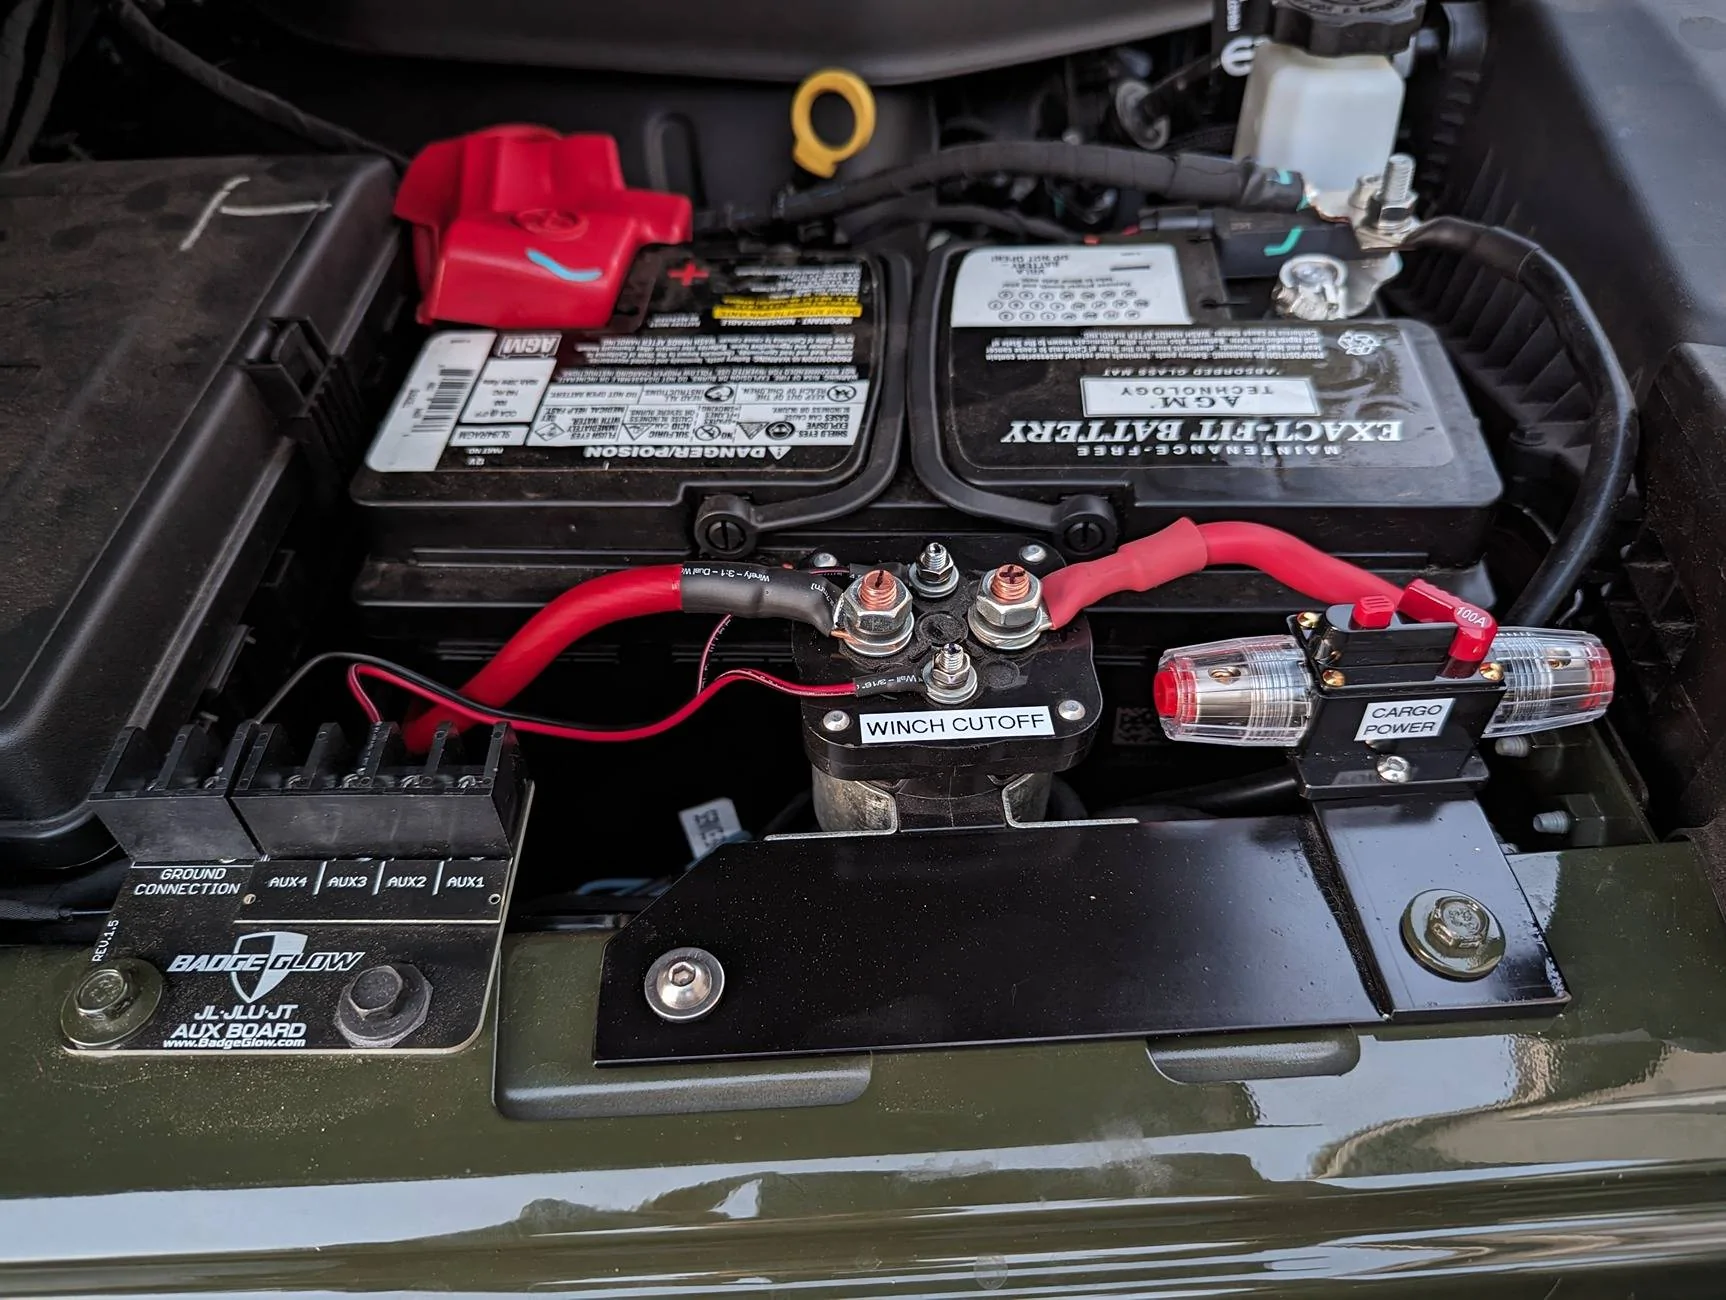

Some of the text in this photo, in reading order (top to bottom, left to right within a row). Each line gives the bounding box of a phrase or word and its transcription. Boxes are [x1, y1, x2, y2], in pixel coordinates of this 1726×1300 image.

[506, 338, 557, 354] AGM
[1102, 368, 1134, 376] MAT
[1138, 368, 1186, 376] GLASS
[1120, 386, 1272, 396] TECHNOLOGY
[1000, 420, 1402, 442] EXACT-FIT BATTERY
[584, 446, 766, 458] DANGER/POISON
[1076, 445, 1340, 456] MAINTENANCE-FREE
[721, 569, 734, 577] 3:1
[744, 572, 770, 582] Wirefy
[1456, 606, 1486, 628] 100A
[896, 674, 916, 682] Wall
[1372, 704, 1442, 719] CARGO
[866, 714, 1044, 736] WINCH CUTOFF
[1364, 722, 1436, 736] POWER
[160, 868, 227, 880] GROUND
[268, 876, 308, 888] AUX4
[327, 876, 368, 888] AUX3
[386, 876, 427, 888] AUX2
[446, 876, 485, 888] AUX1
[134, 883, 240, 896] CONNECTION
[92, 919, 120, 962] REV.1.5
[170, 1022, 306, 1039] AUX BOARD
[163, 1037, 306, 1050] www.BadgeGlow.com
